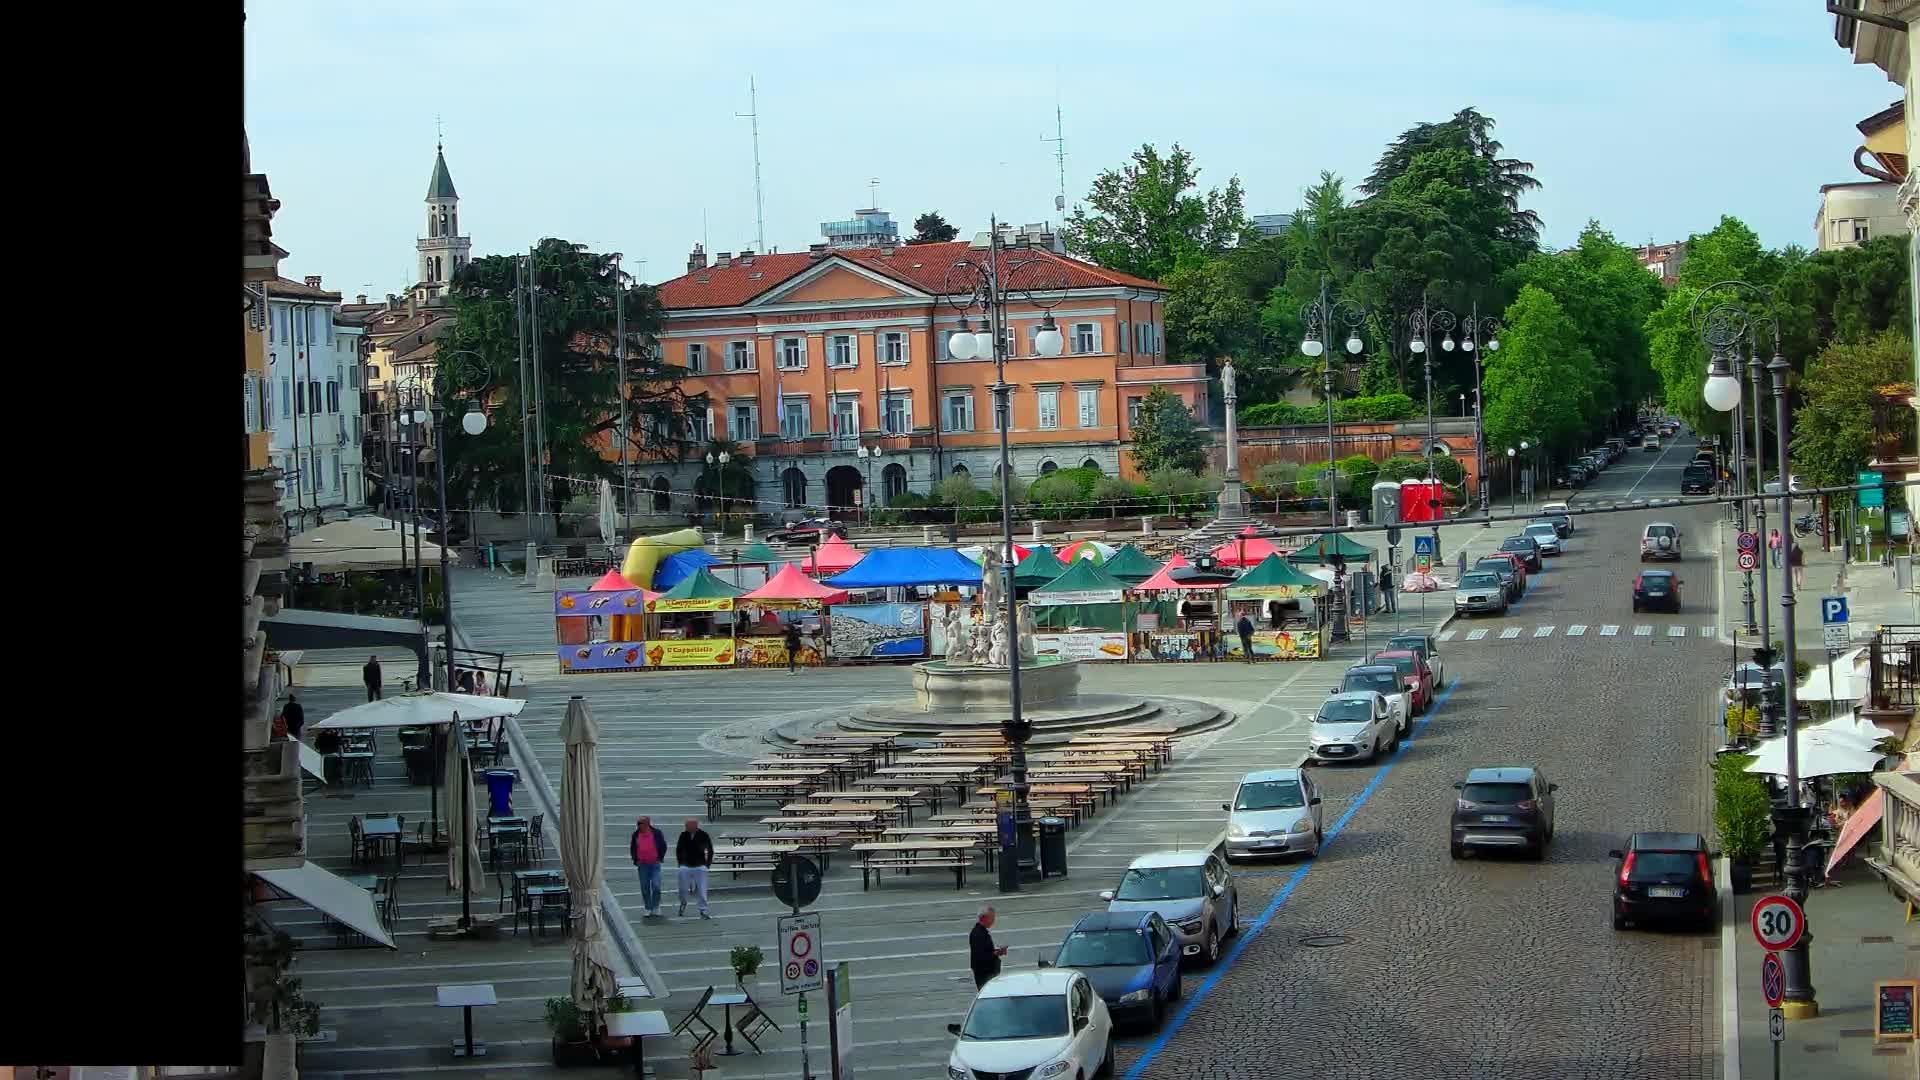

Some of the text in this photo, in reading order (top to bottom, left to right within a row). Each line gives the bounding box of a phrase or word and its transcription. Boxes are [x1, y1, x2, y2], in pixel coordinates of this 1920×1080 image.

[1742, 556, 1753, 566] 20
[1827, 601, 1842, 621] P
[1762, 910, 1792, 937] 30
